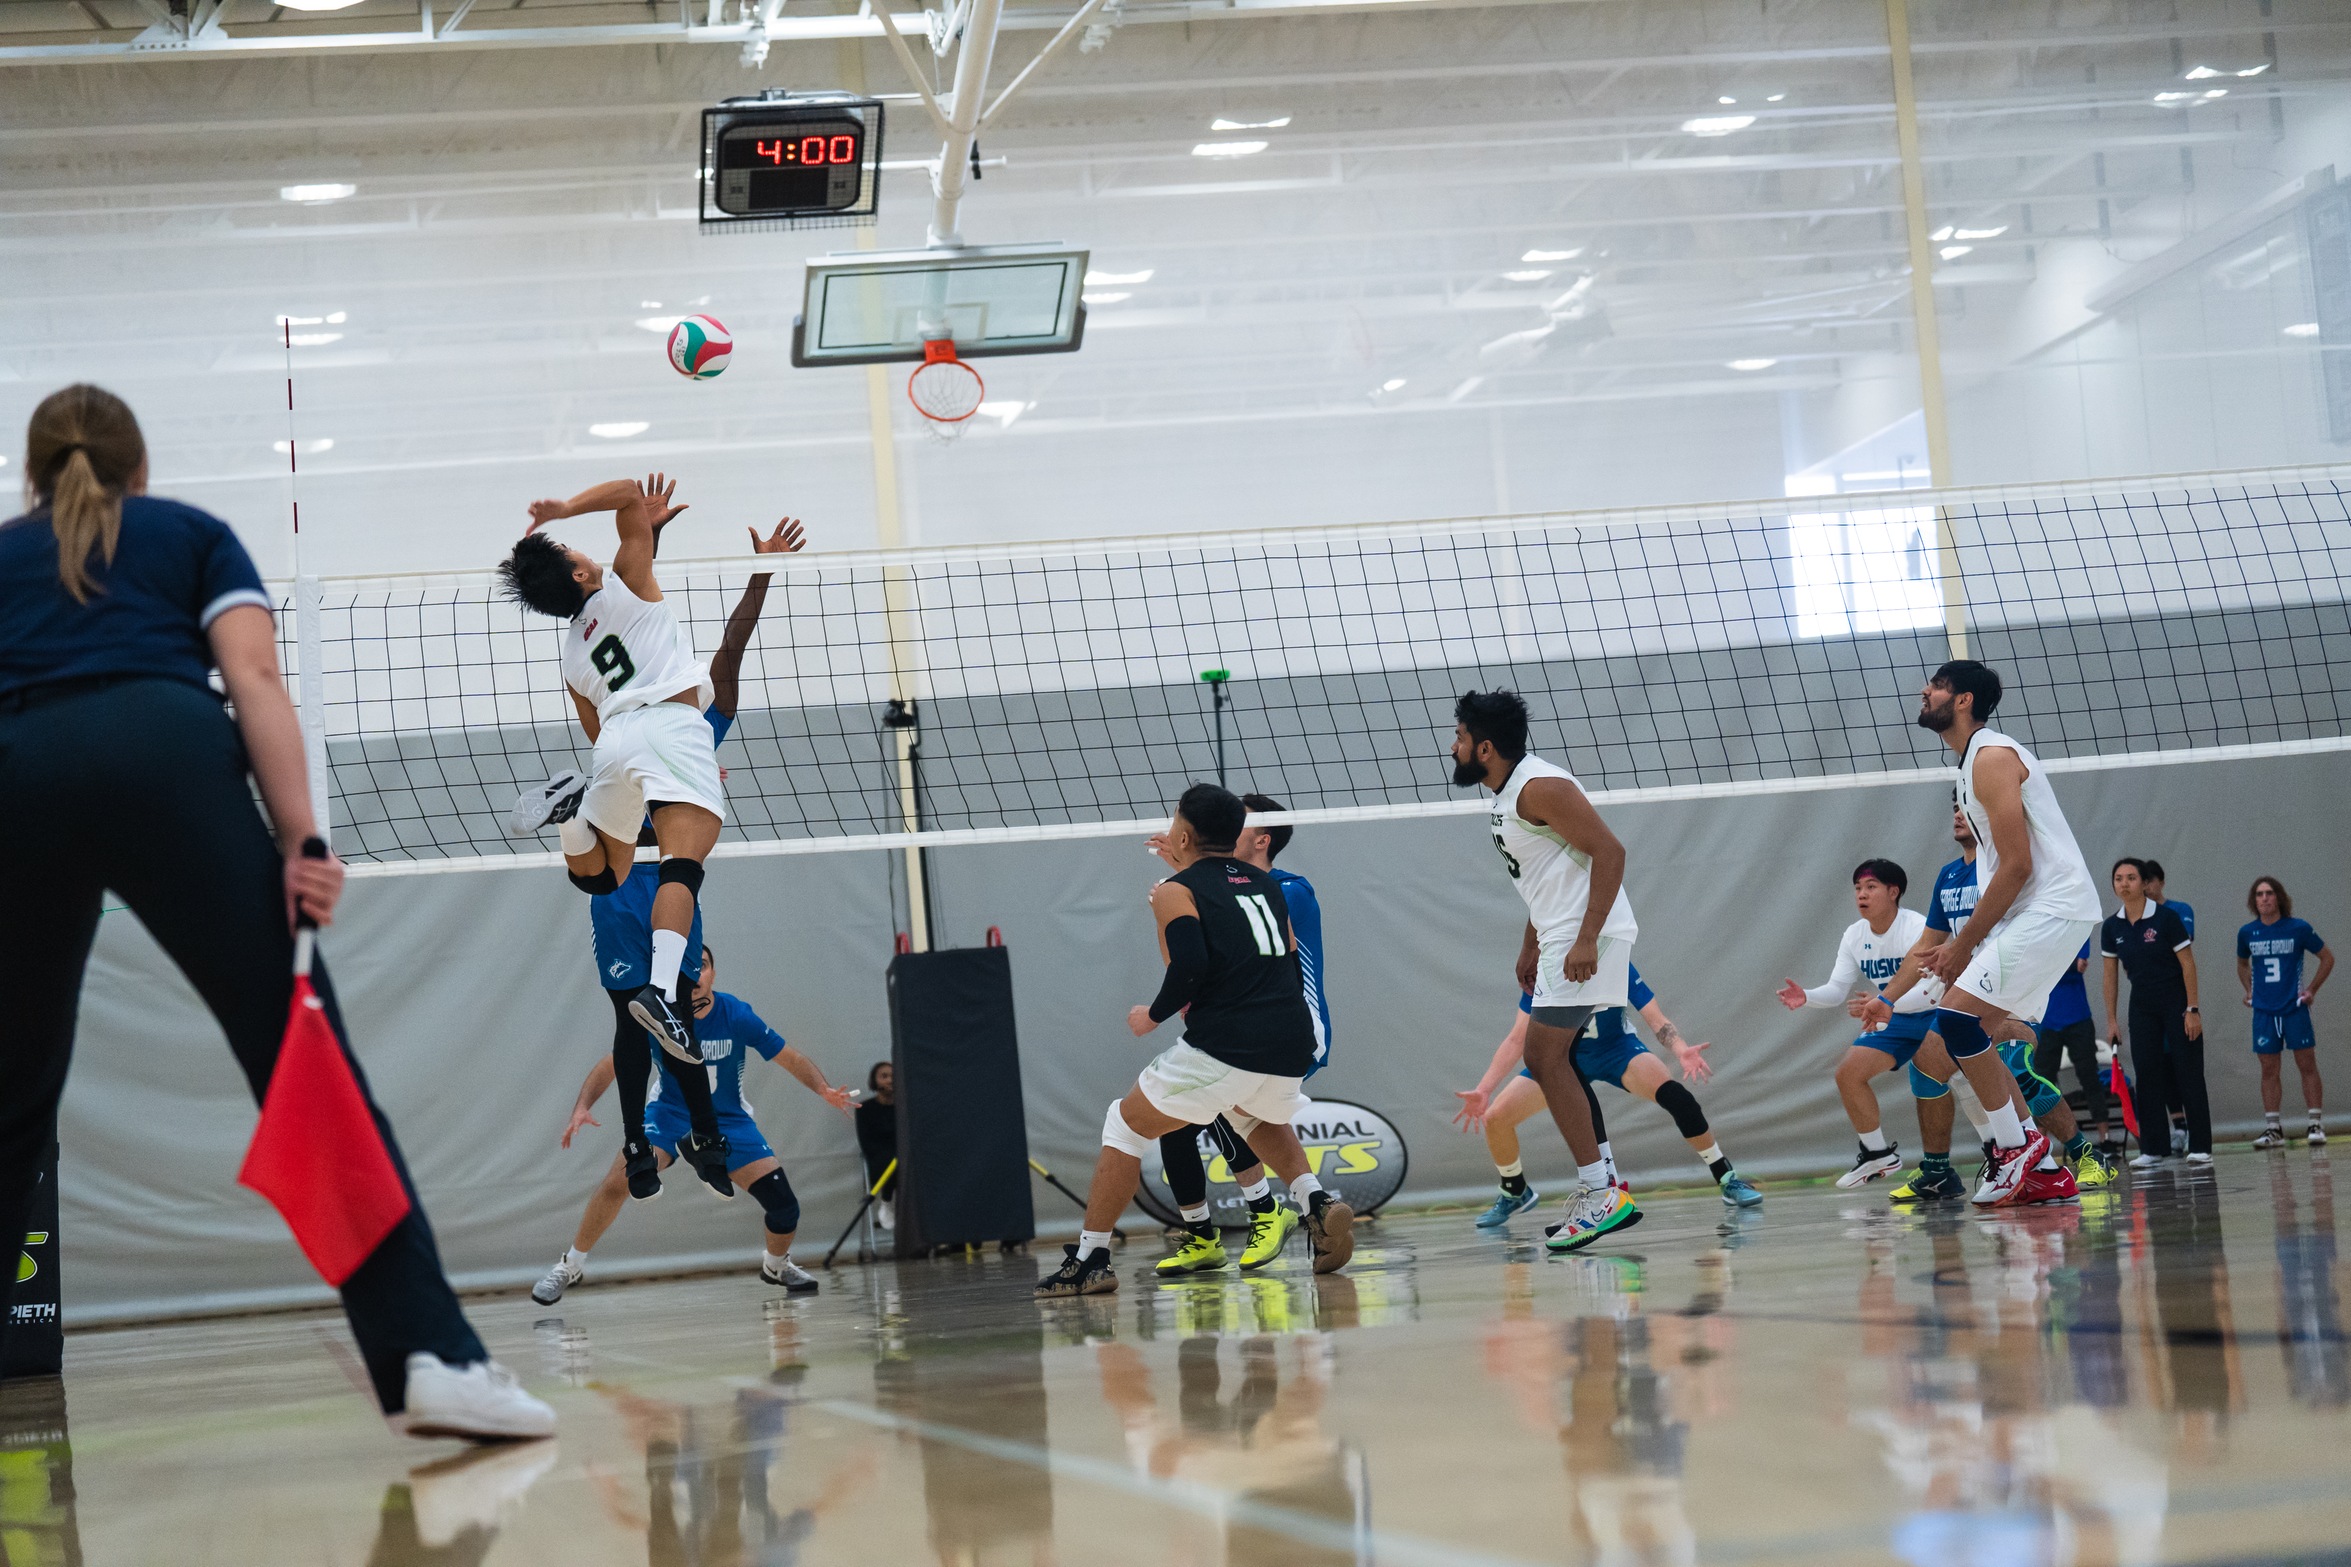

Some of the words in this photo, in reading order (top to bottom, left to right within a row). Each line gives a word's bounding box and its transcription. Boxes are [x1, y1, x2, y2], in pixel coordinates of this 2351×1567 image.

[757, 135, 855, 165] 4:00
[590, 634, 635, 693] 9
[1235, 894, 1286, 956] 11
[2264, 957, 2281, 983] 3
[10, 1303, 57, 1319] PIETH
